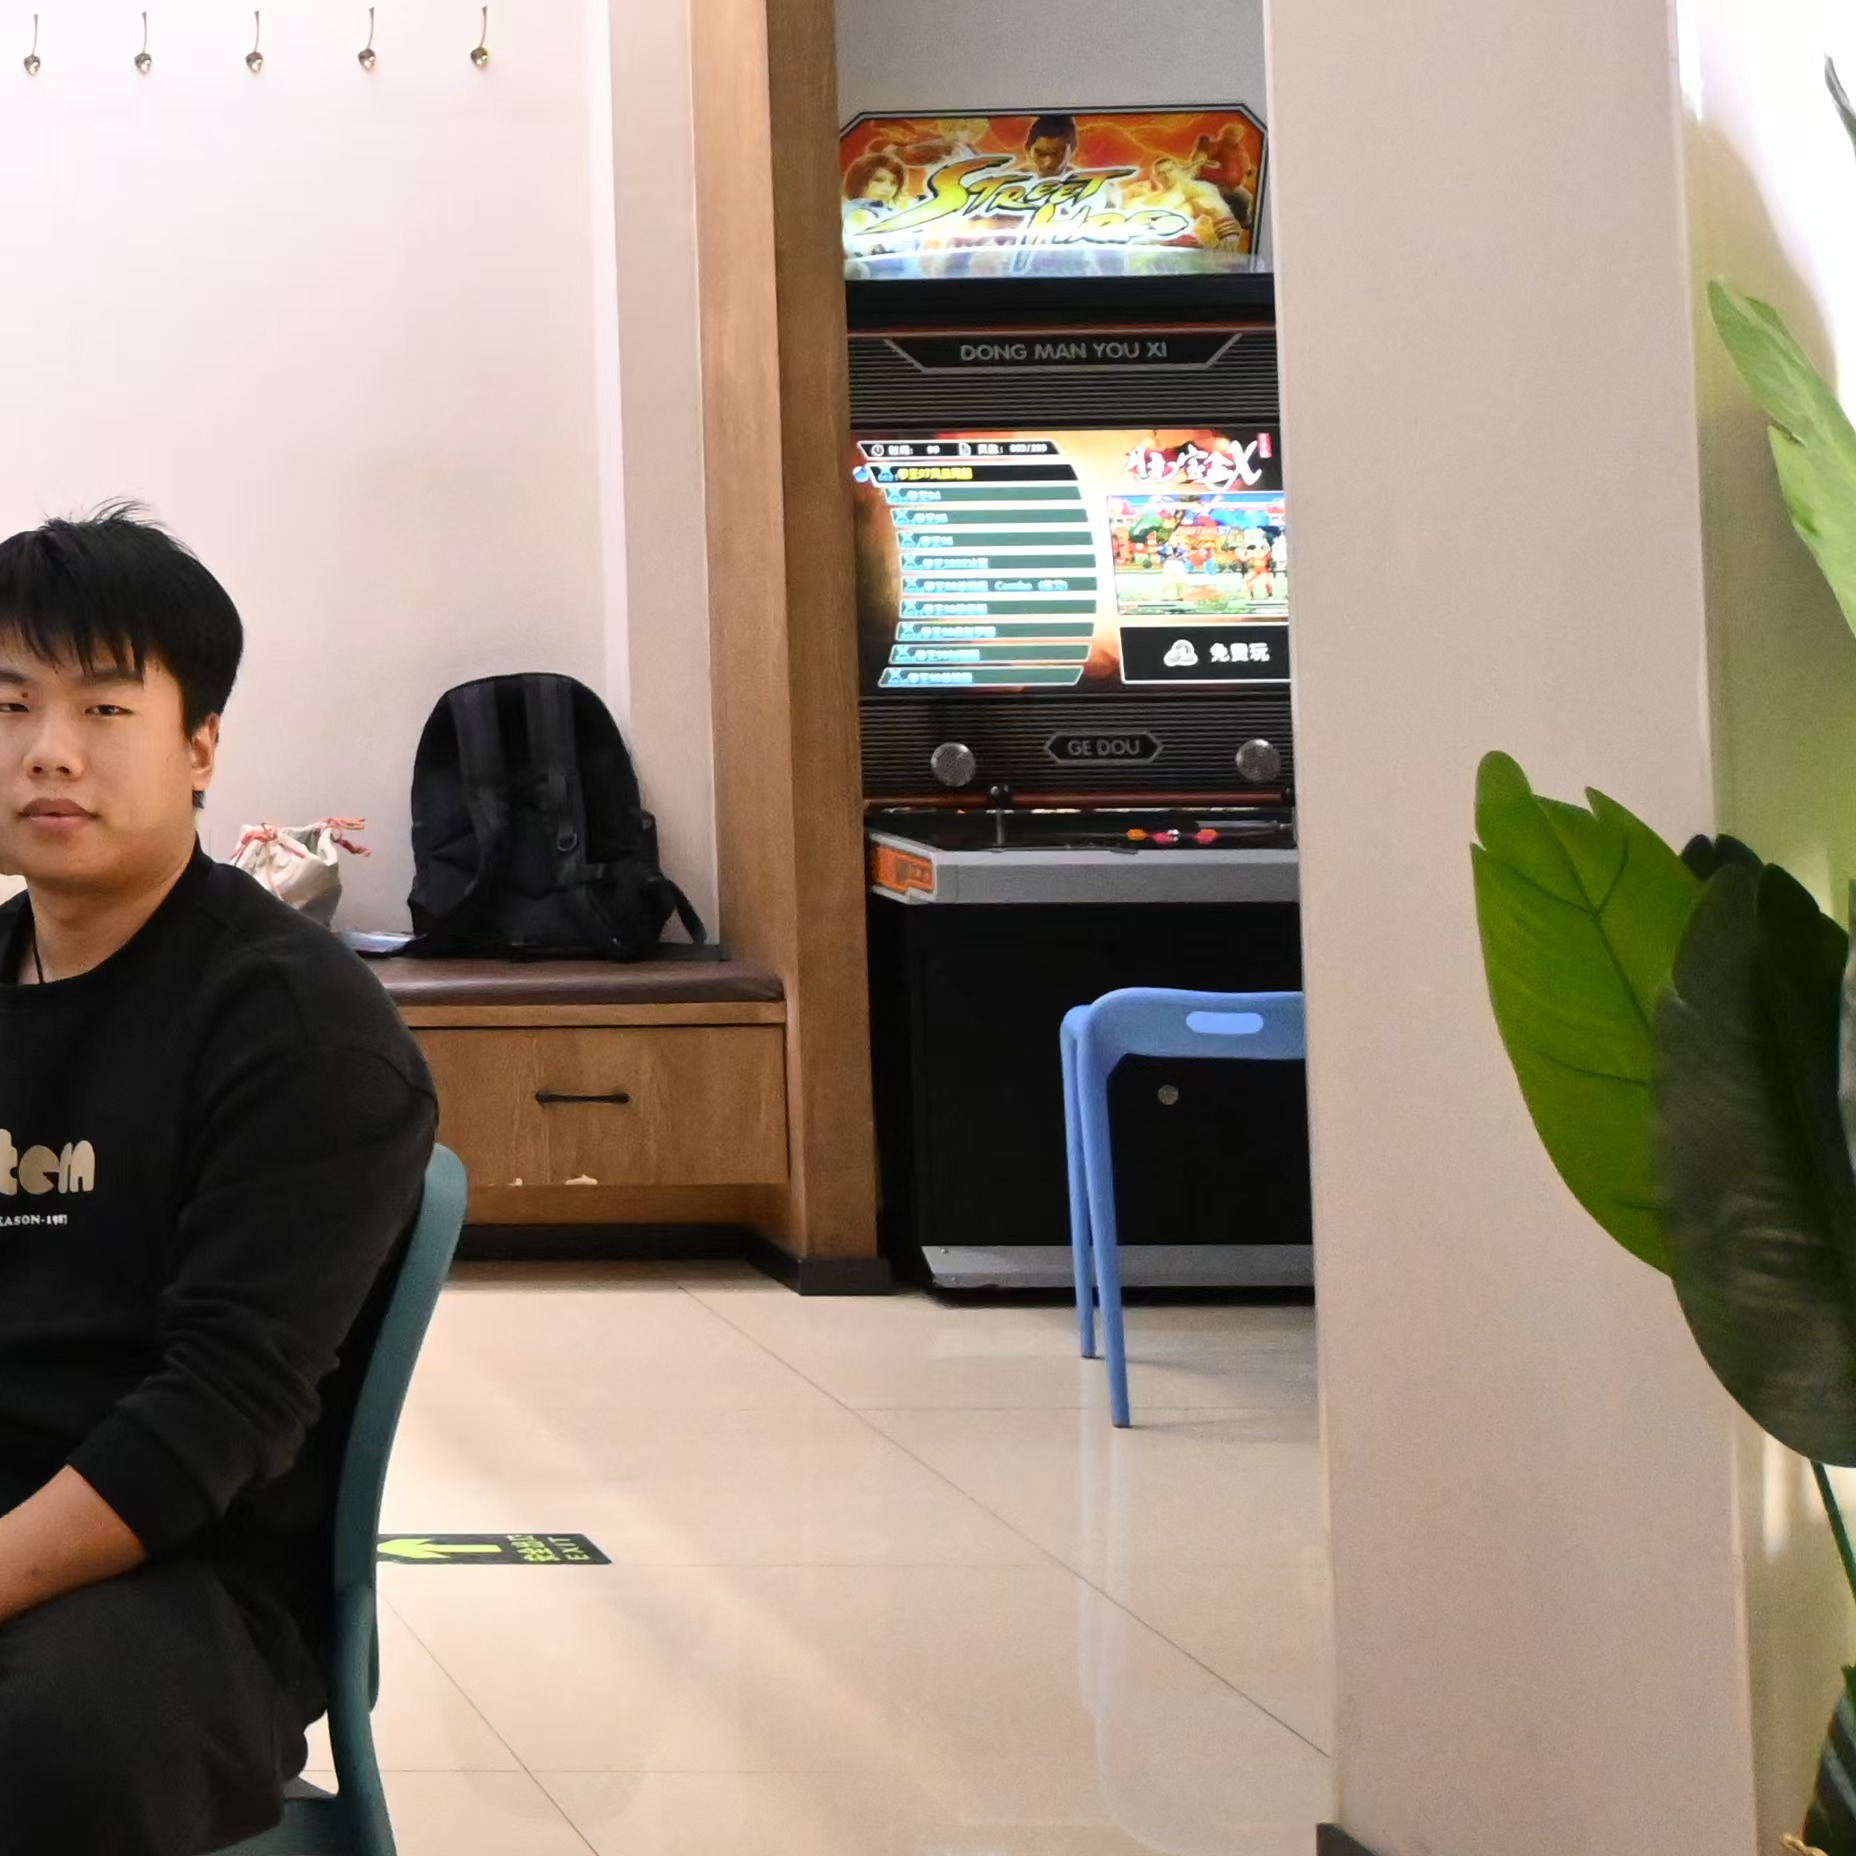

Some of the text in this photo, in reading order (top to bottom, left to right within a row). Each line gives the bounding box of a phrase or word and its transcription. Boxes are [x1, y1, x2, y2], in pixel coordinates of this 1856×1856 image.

[960, 341, 1168, 361] DONG MAN YOU XI
[1067, 739, 1140, 757] GE DOU
[548, 1536, 591, 1561] EXIT
